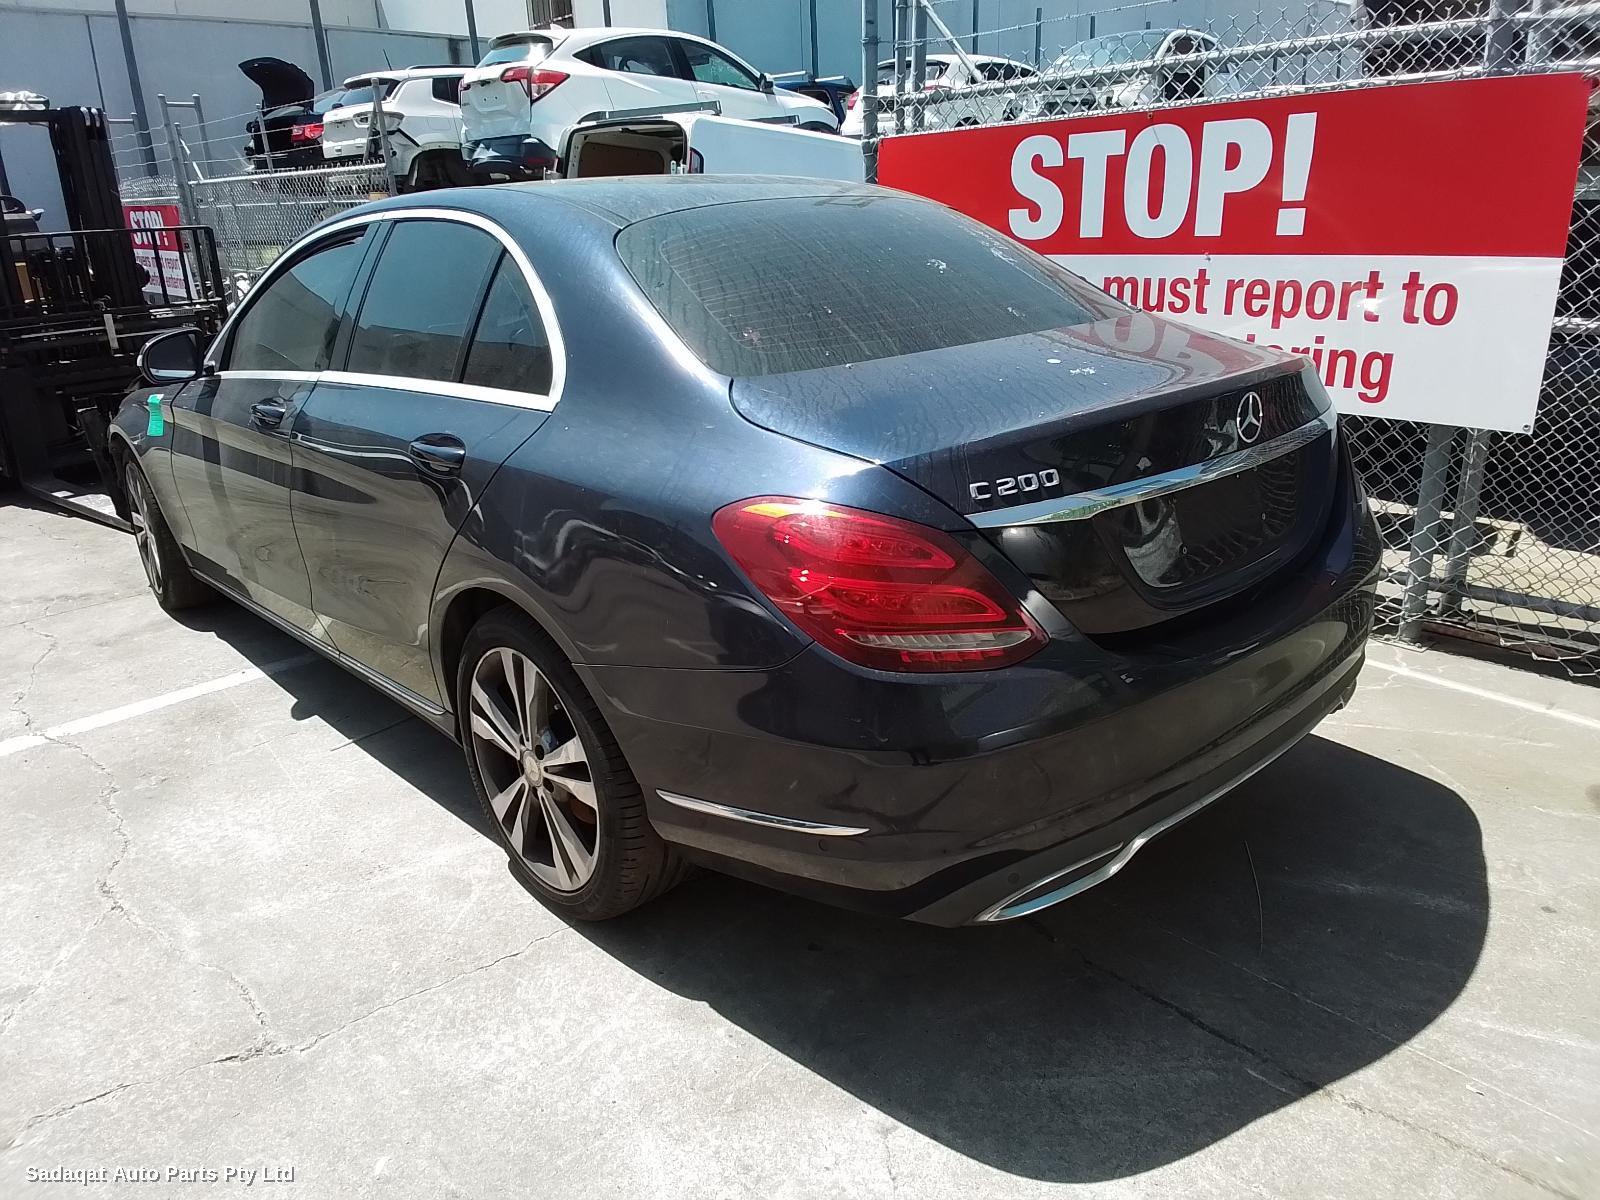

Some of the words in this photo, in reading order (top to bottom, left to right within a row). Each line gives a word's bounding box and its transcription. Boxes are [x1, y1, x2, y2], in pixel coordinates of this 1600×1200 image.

[1008, 111, 1318, 240] STOP!
[1103, 268, 1211, 314] must
[1223, 270, 1385, 330] report
[1402, 271, 1459, 326] to
[969, 481, 993, 500] C
[996, 468, 1060, 496] 200
